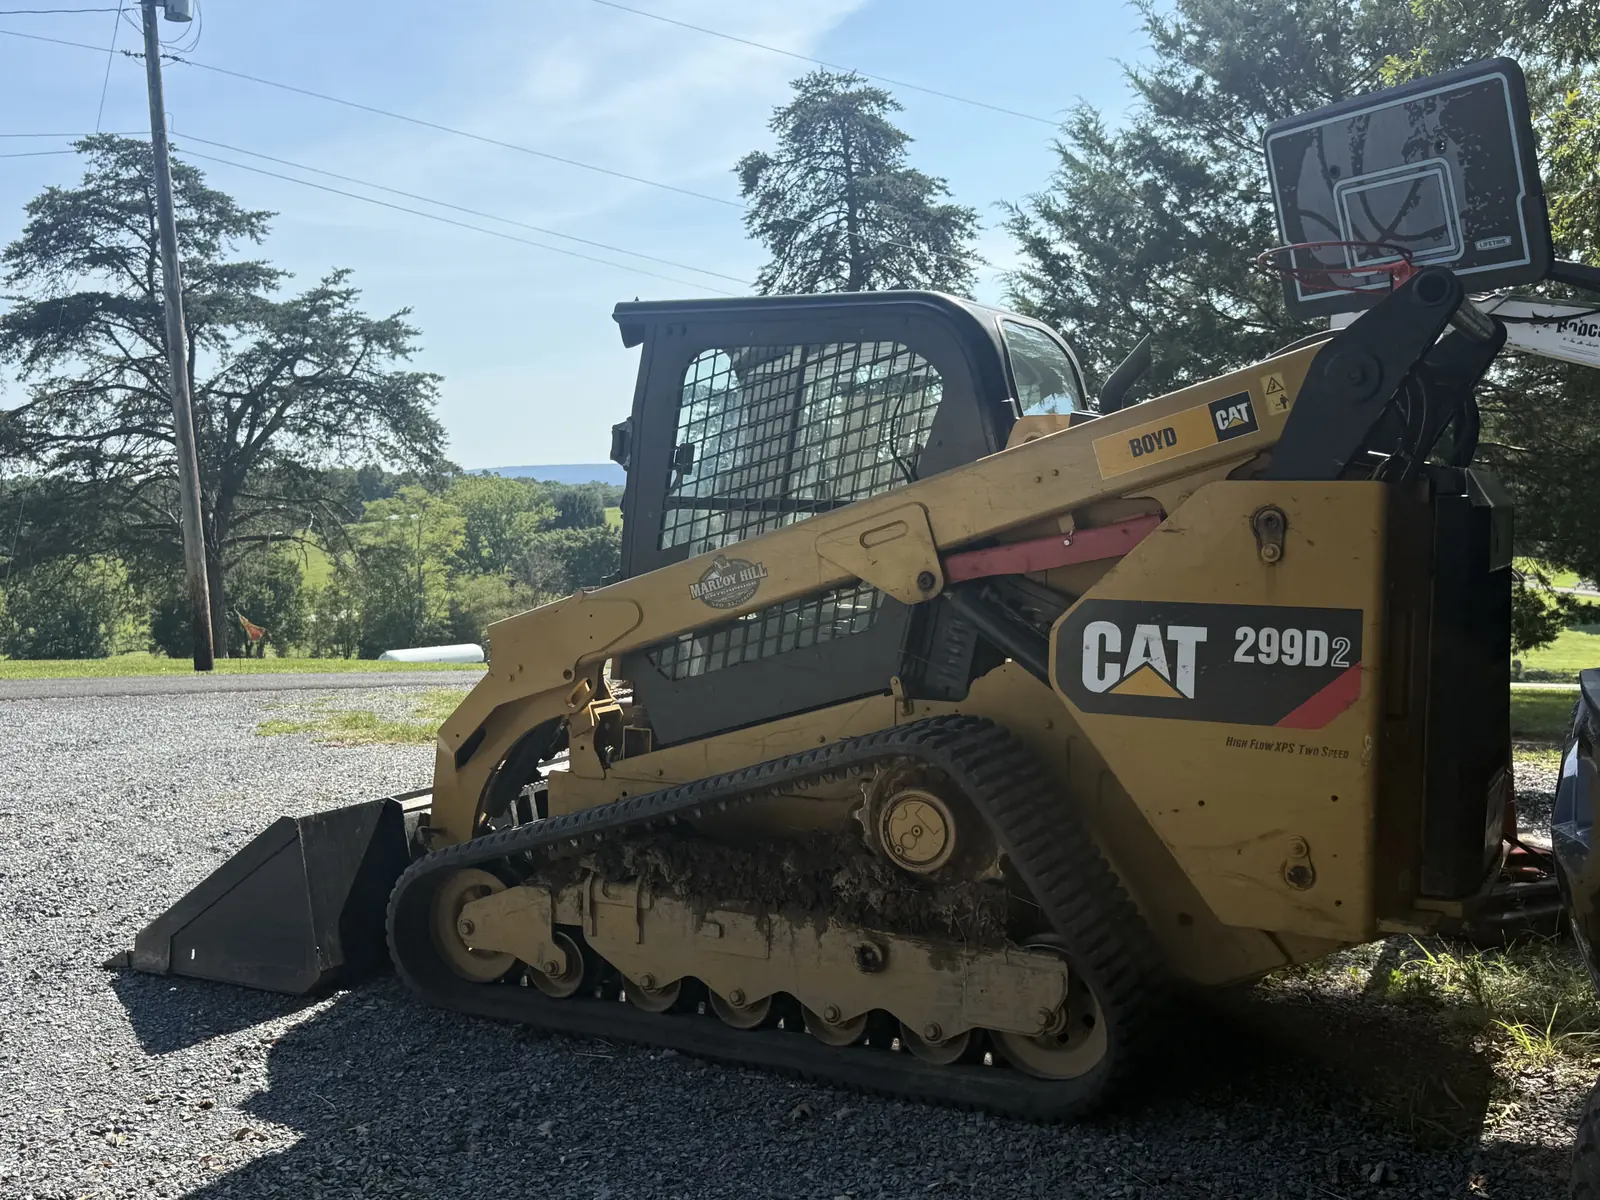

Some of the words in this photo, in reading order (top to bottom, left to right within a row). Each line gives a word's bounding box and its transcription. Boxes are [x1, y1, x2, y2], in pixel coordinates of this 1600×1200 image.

[1215, 402, 1249, 431] CAT
[1129, 427, 1177, 457] BOYD
[740, 562, 768, 582] HILL
[1082, 621, 1208, 699] CAT
[1274, 741, 1296, 754] XPS
